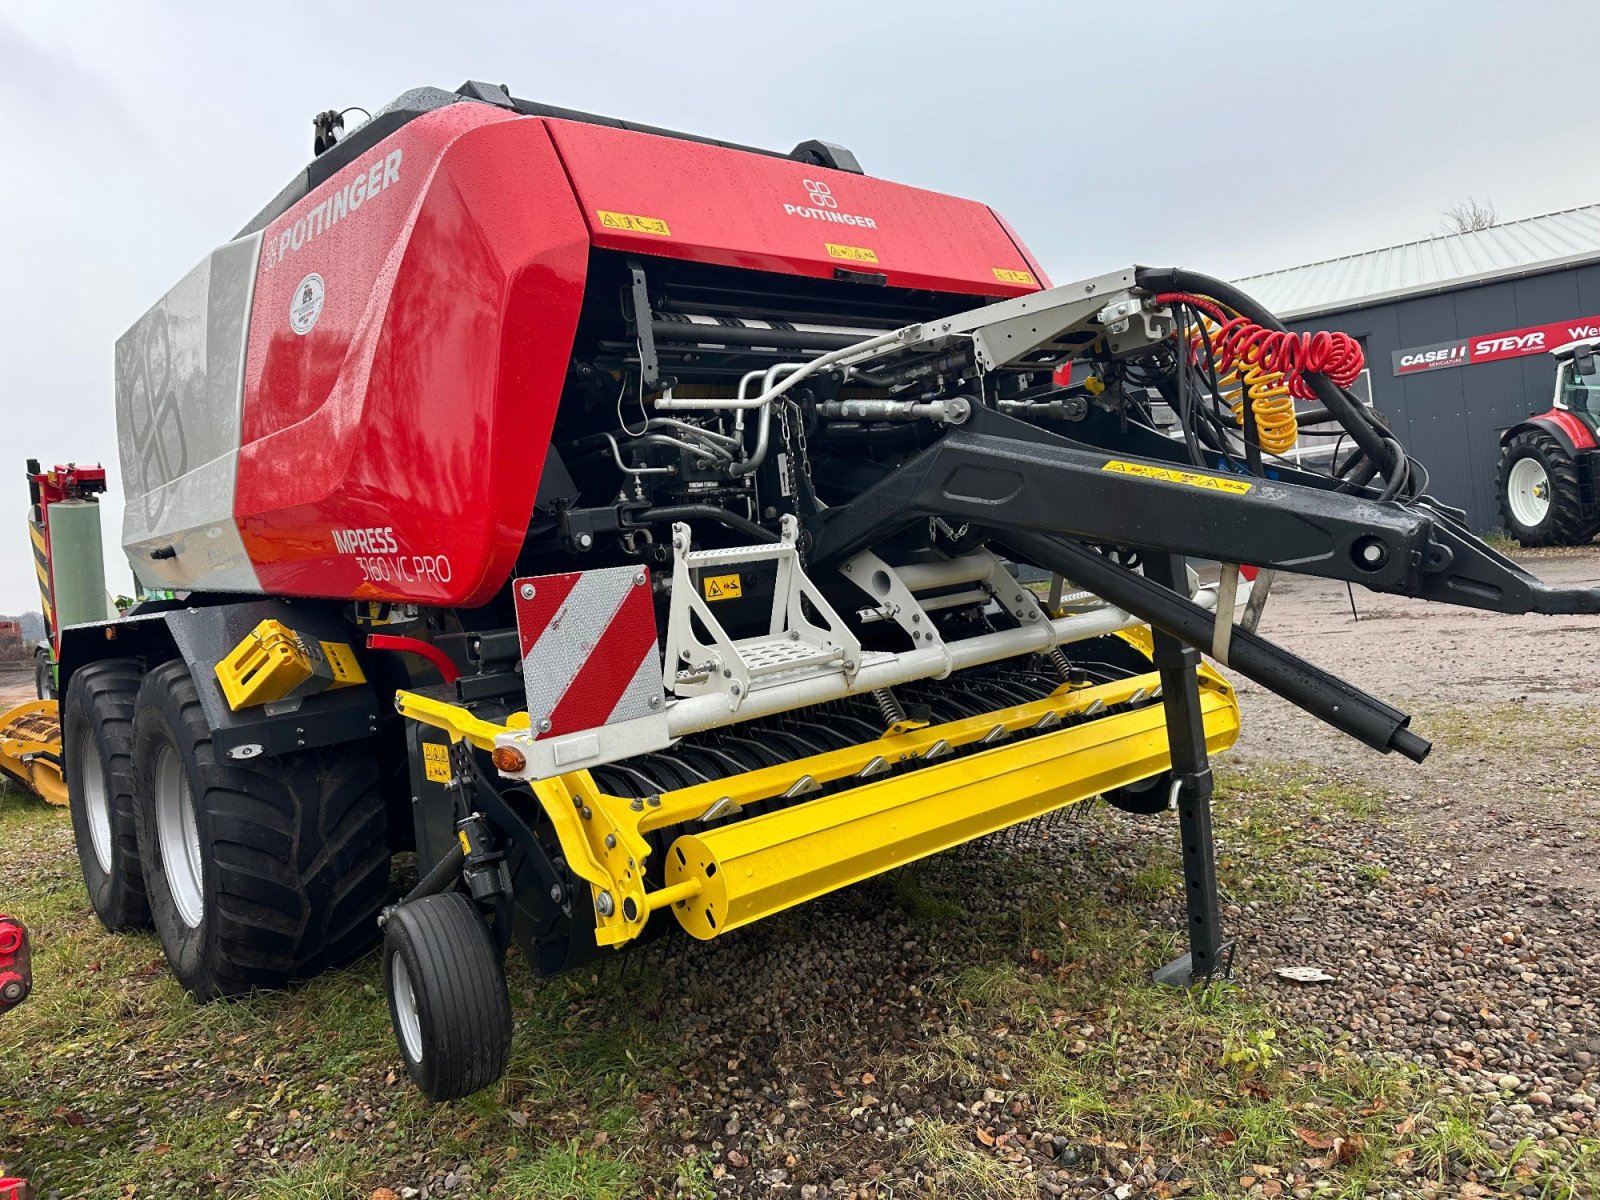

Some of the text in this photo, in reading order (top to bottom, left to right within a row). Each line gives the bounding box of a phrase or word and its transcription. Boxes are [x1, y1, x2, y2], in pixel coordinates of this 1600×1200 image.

[1474, 332, 1546, 356] STEYR
[1400, 348, 1449, 367] CASE
[331, 526, 398, 555] IMPRESS
[355, 554, 452, 583] 3160 VC PRO
